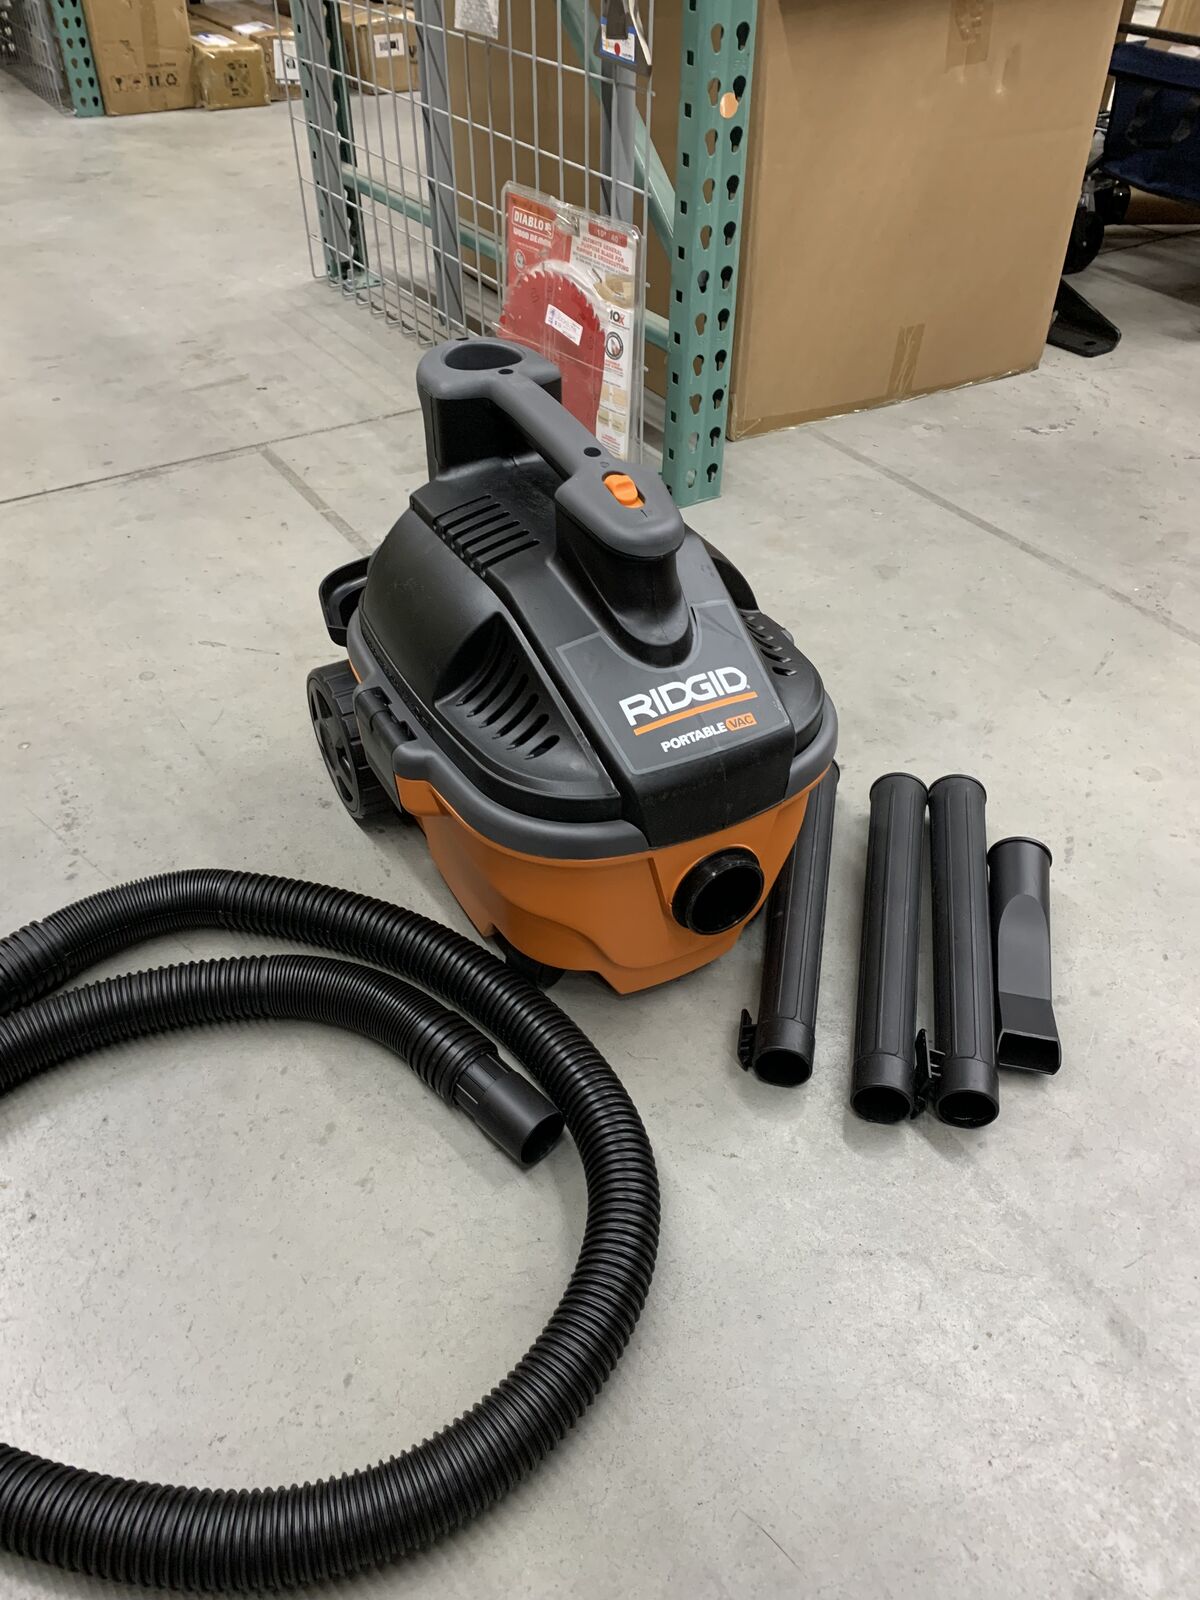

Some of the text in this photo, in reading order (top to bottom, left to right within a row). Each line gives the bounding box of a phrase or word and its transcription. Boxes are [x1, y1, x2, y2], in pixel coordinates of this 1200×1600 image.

[514, 210, 544, 231] DIABLO
[614, 254, 624, 263] FOR
[609, 309, 625, 326] 10X
[618, 667, 748, 727] RIDGID
[660, 715, 754, 753] PORTABLE VAC
